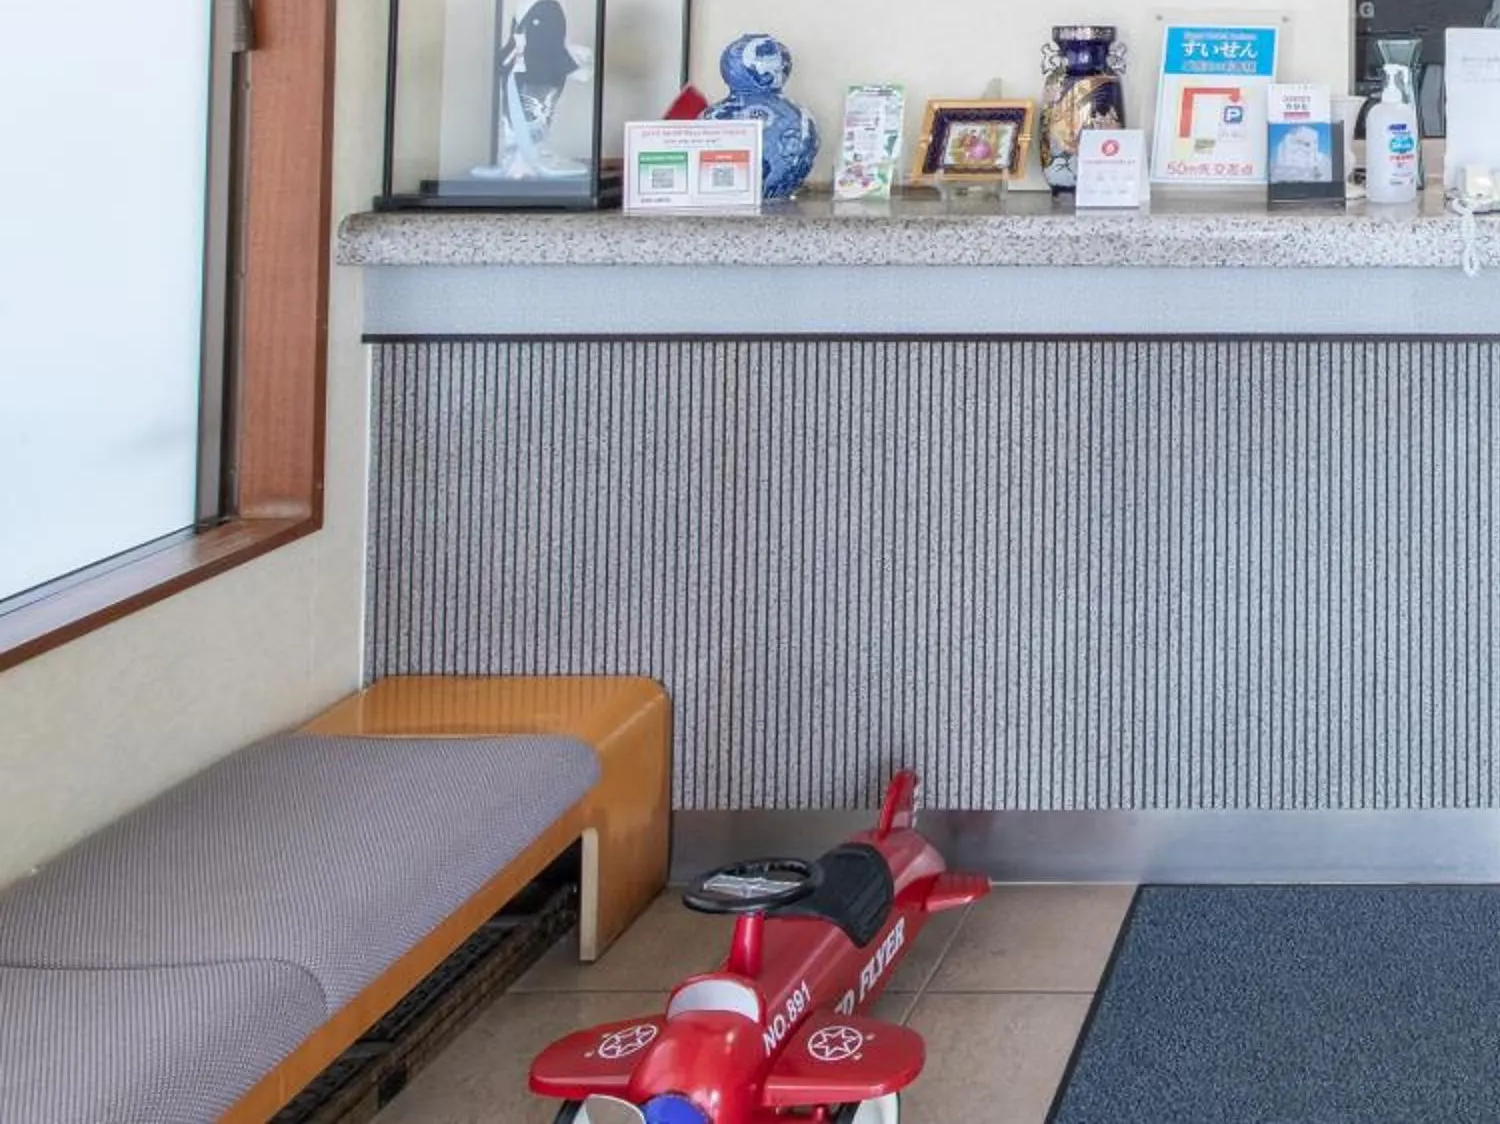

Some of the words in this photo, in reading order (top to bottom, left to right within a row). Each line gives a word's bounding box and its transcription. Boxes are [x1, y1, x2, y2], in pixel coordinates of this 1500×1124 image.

[1356, 1, 1375, 18] G
[1181, 40, 1258, 59] すいせん
[859, 916, 905, 1004] FLYER
[762, 979, 811, 1057] NO.891
